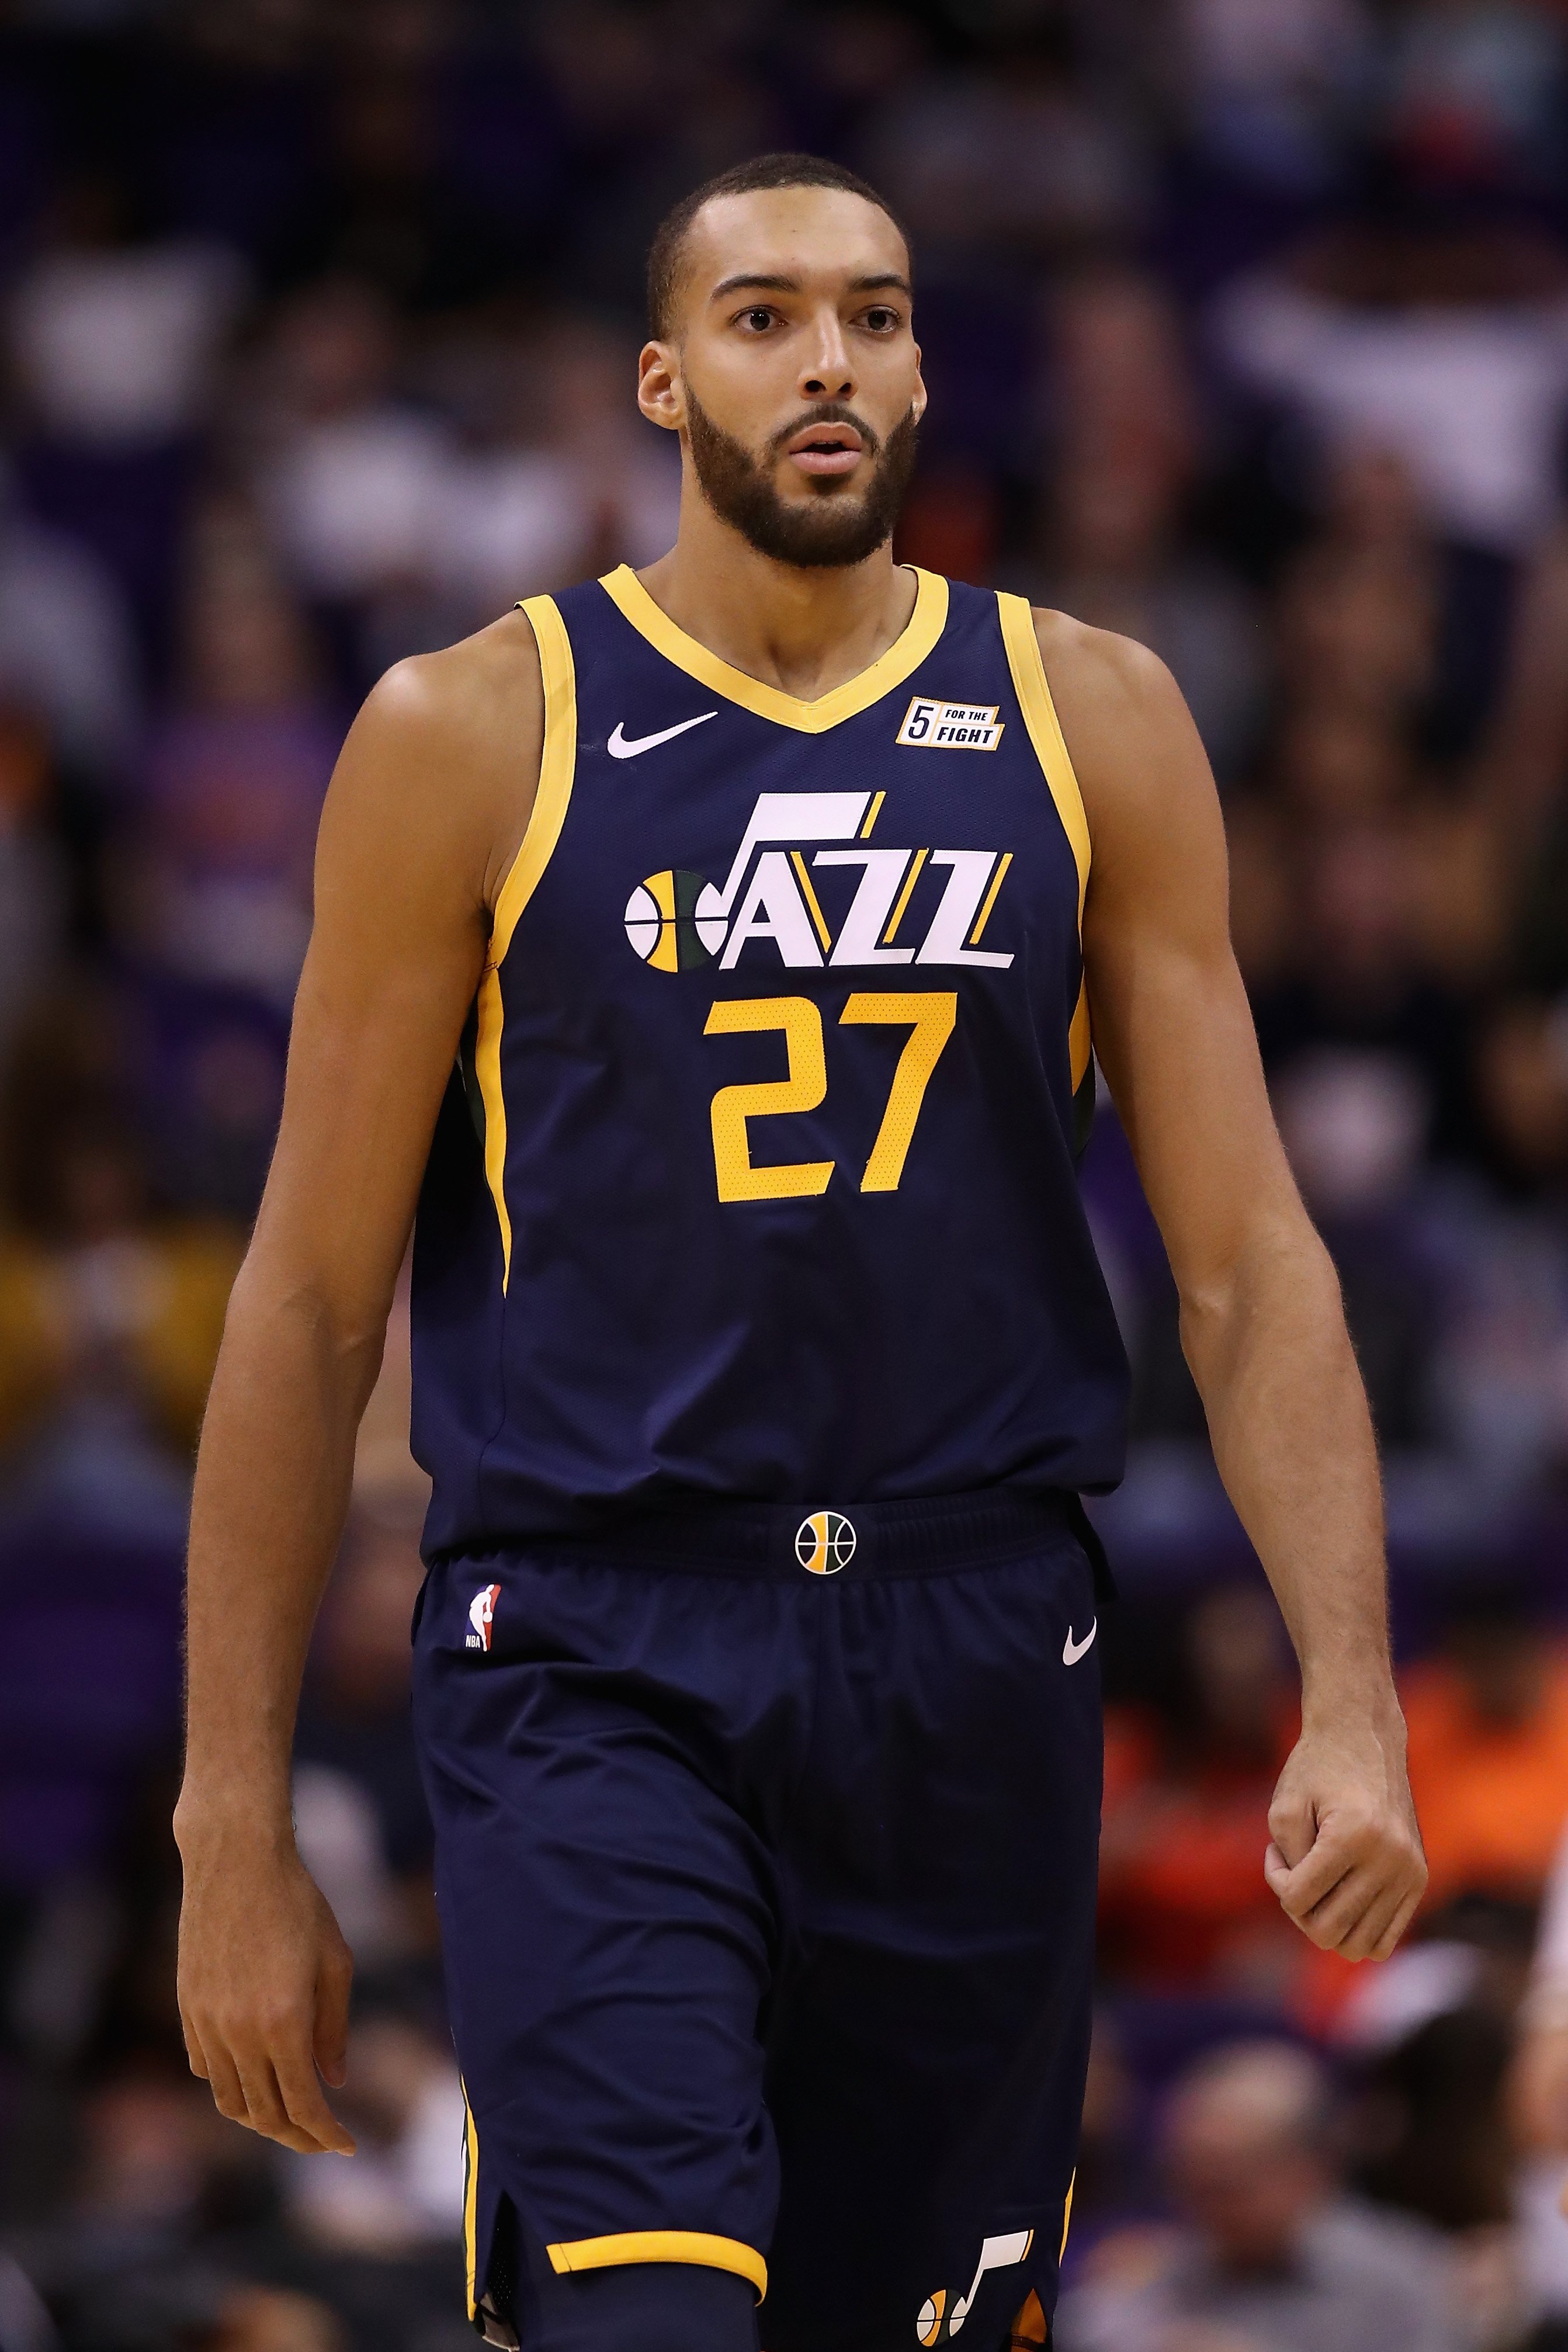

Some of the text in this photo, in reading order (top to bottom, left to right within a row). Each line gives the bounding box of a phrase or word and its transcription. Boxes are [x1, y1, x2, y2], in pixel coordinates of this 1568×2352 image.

[908, 705, 934, 739] 5
[945, 709, 988, 721] FOR THE
[936, 727, 993, 744] FIGHT
[624, 791, 1015, 973] JAZZ
[703, 992, 958, 1202] 27
[466, 1635, 480, 1648] NBA
